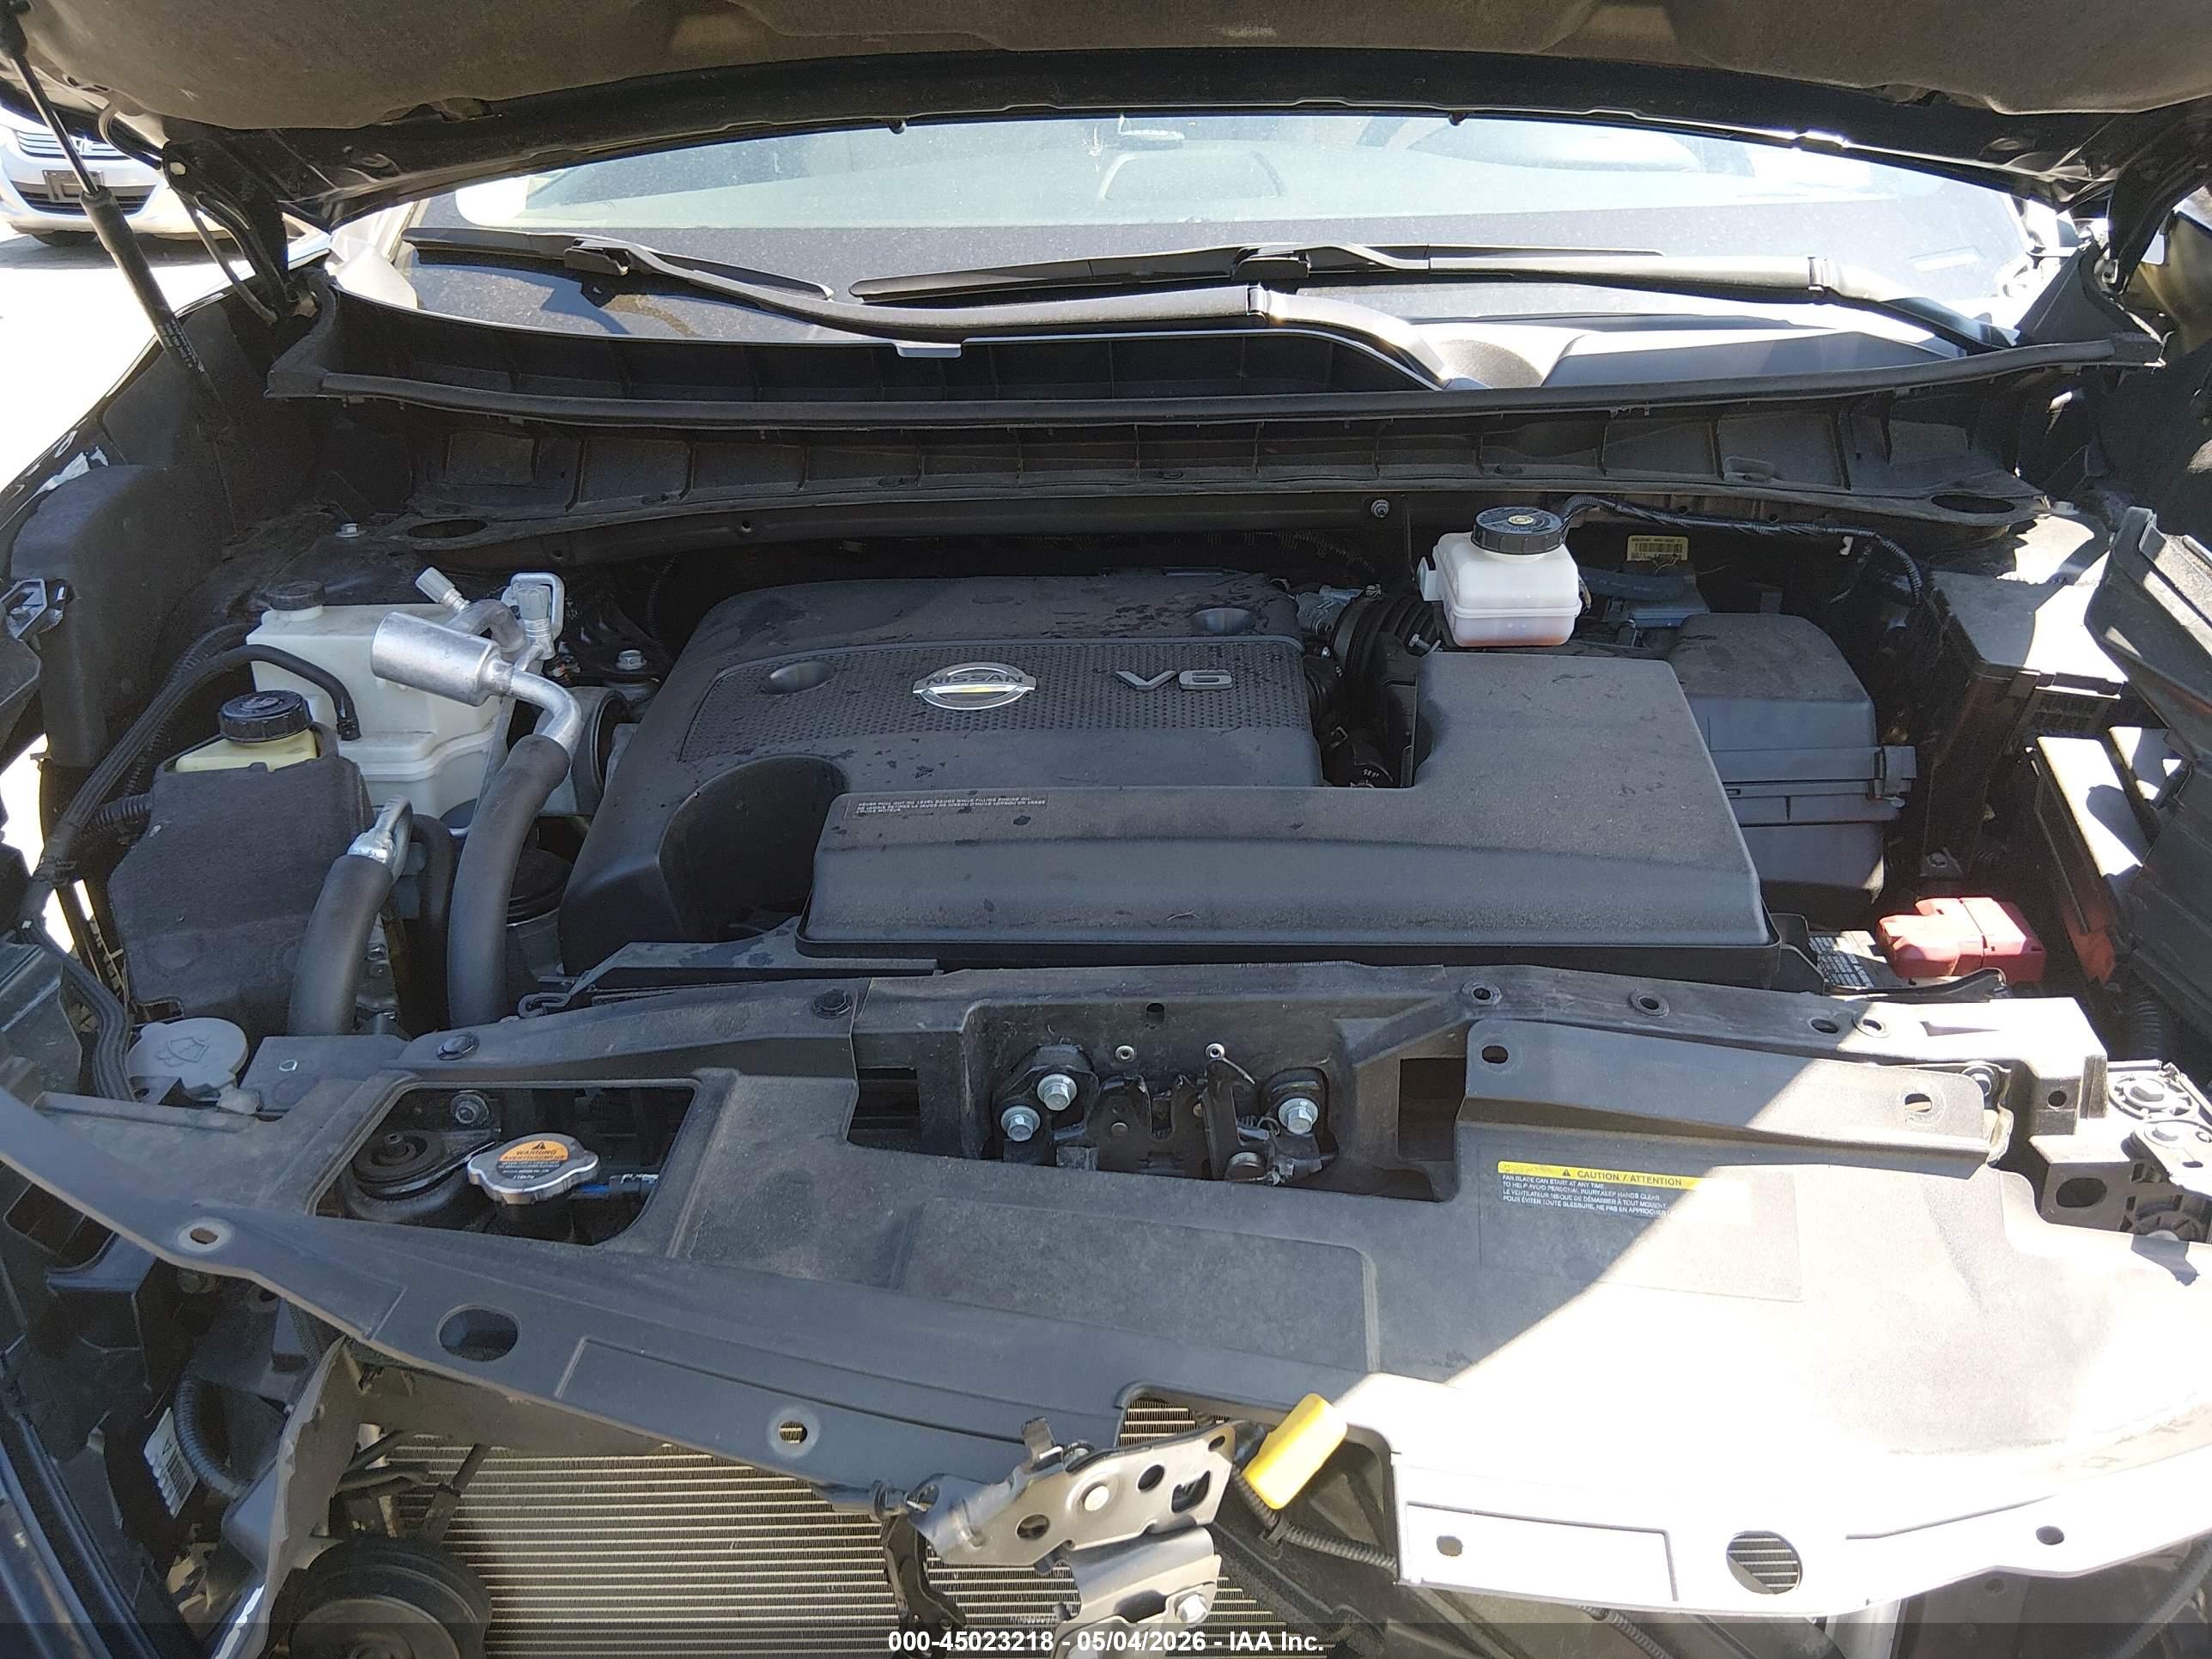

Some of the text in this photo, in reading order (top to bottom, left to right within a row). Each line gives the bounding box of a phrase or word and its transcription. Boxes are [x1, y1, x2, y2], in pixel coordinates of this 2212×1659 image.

[927, 674, 1023, 685] NISSAN
[1114, 669, 1234, 692] V6
[1577, 1170, 1620, 1182] CAUTION
[1630, 1175, 1682, 1187] ATTENTION
[1510, 1188, 1549, 1198] VENTILATEUR
[1547, 1185, 1579, 1194] PERSONAL
[1617, 1190, 1639, 1199] HANDS
